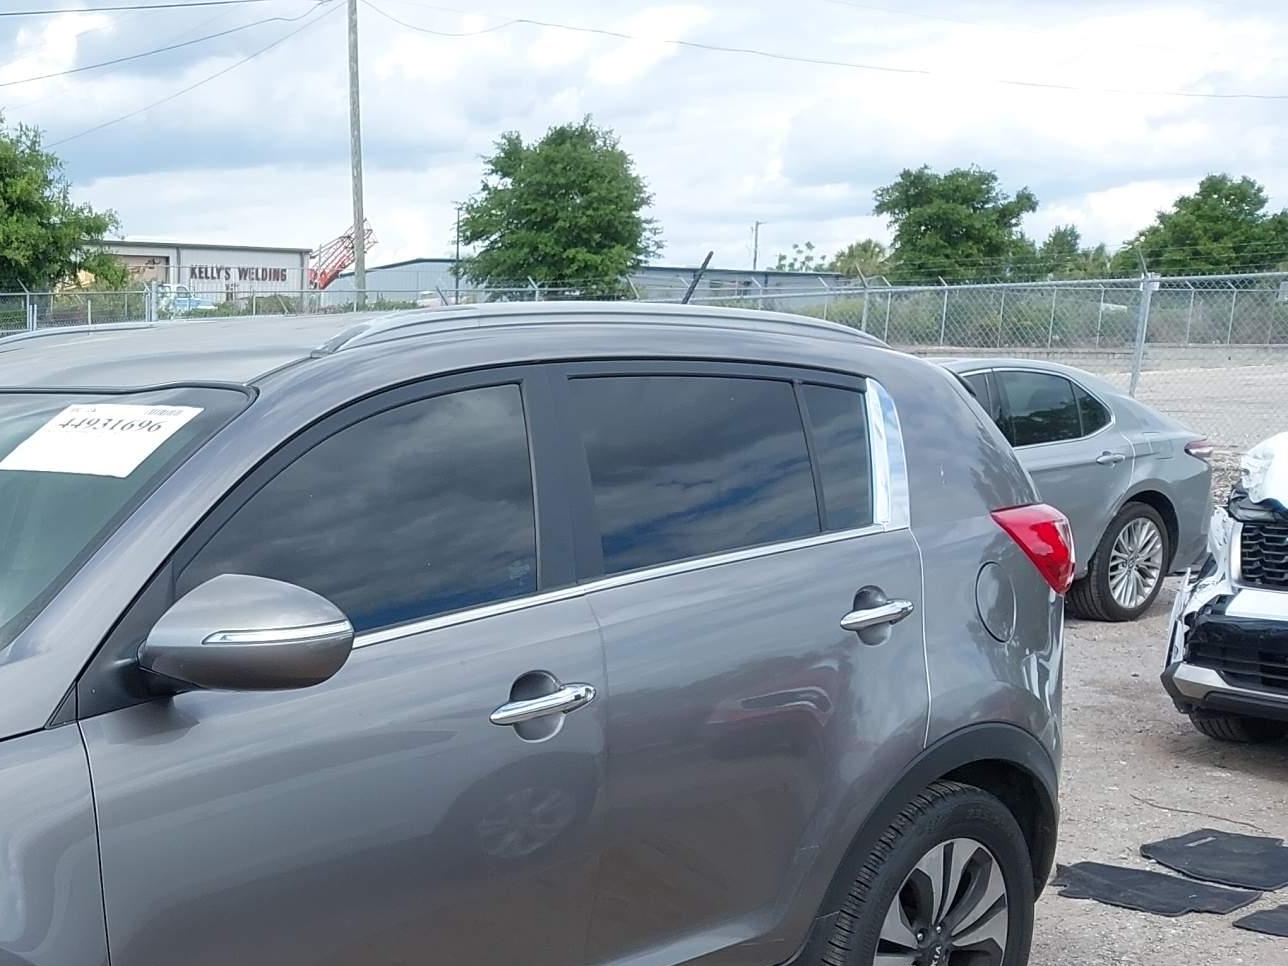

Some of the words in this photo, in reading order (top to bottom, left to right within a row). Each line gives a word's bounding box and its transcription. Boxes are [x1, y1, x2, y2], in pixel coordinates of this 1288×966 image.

[190, 266, 231, 280] KELLY'S
[238, 267, 287, 281] WELDING
[58, 417, 167, 432] 44931696
